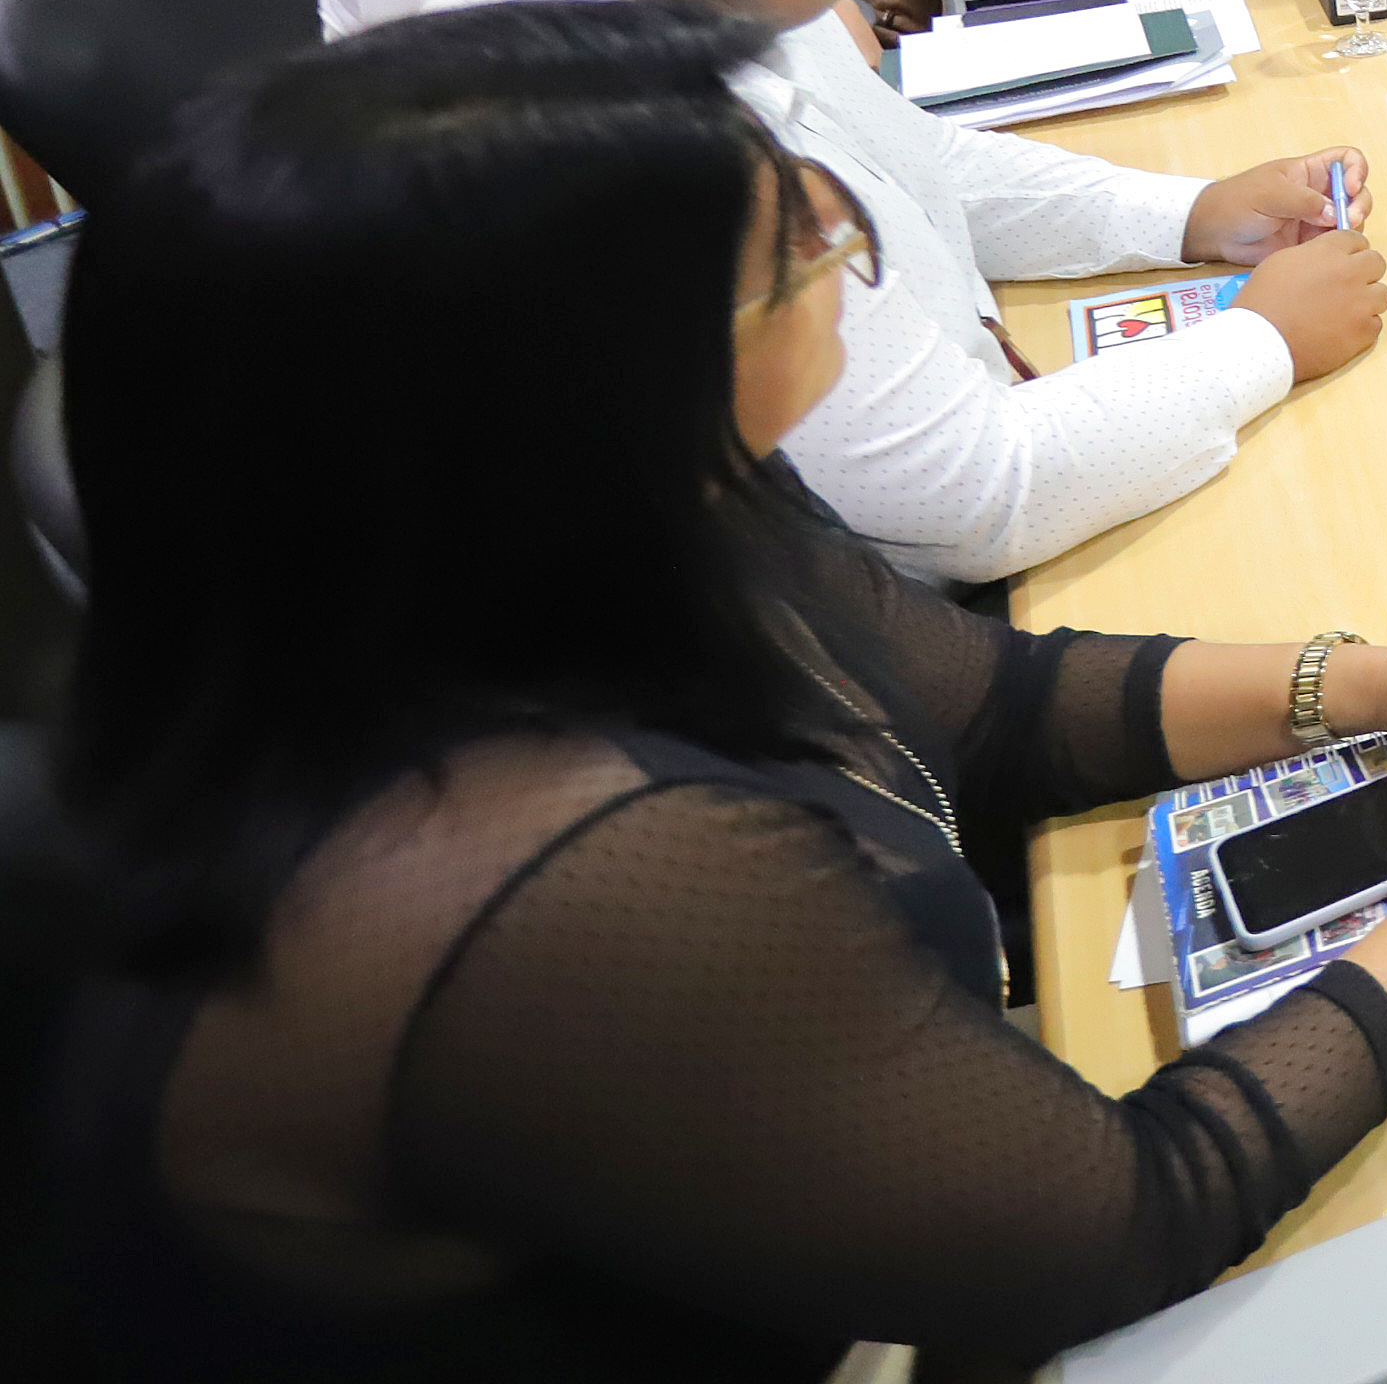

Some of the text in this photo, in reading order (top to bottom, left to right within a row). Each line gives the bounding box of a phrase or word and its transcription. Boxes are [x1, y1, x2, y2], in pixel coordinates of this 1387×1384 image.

[1171, 288, 1203, 327] storal
[1199, 284, 1216, 316] erária
[1190, 869, 1216, 919] AGENDA
